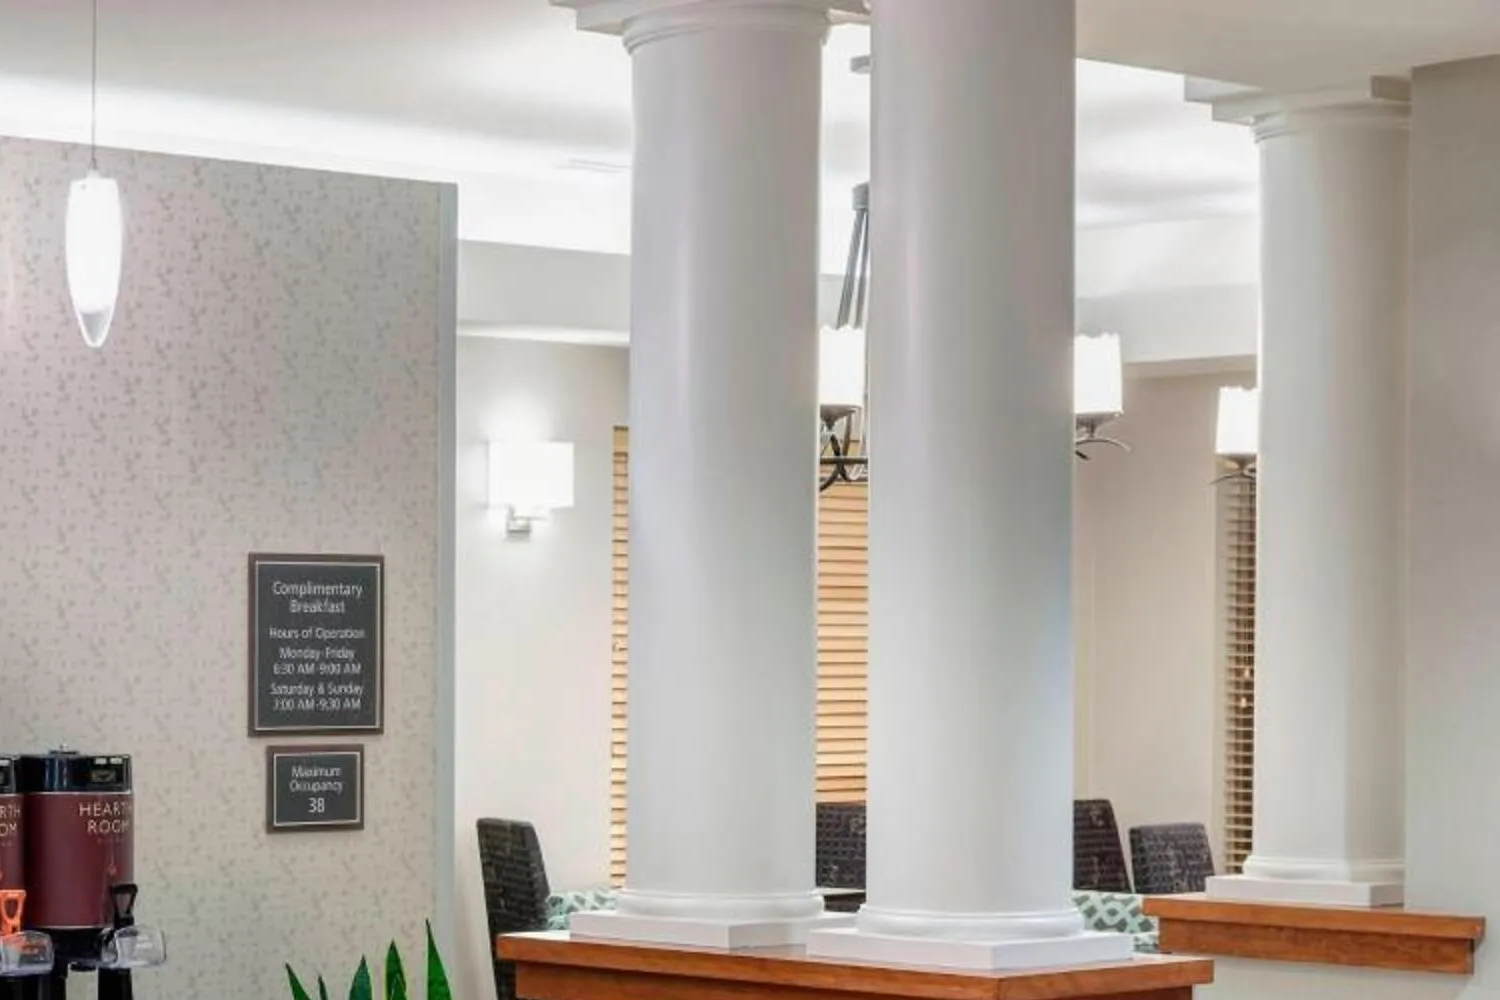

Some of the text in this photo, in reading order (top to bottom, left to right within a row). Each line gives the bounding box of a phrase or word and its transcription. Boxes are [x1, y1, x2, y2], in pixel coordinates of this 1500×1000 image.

[273, 580, 363, 598] Complimentary
[290, 599, 345, 613] Breakfast
[269, 626, 365, 640] Hours of Operation
[343, 663, 361, 674] AM
[269, 682, 315, 697] Saturday
[327, 683, 363, 697] Sunday
[342, 698, 361, 710] AM
[291, 765, 341, 778] Maximum
[289, 780, 343, 796] Occupancy
